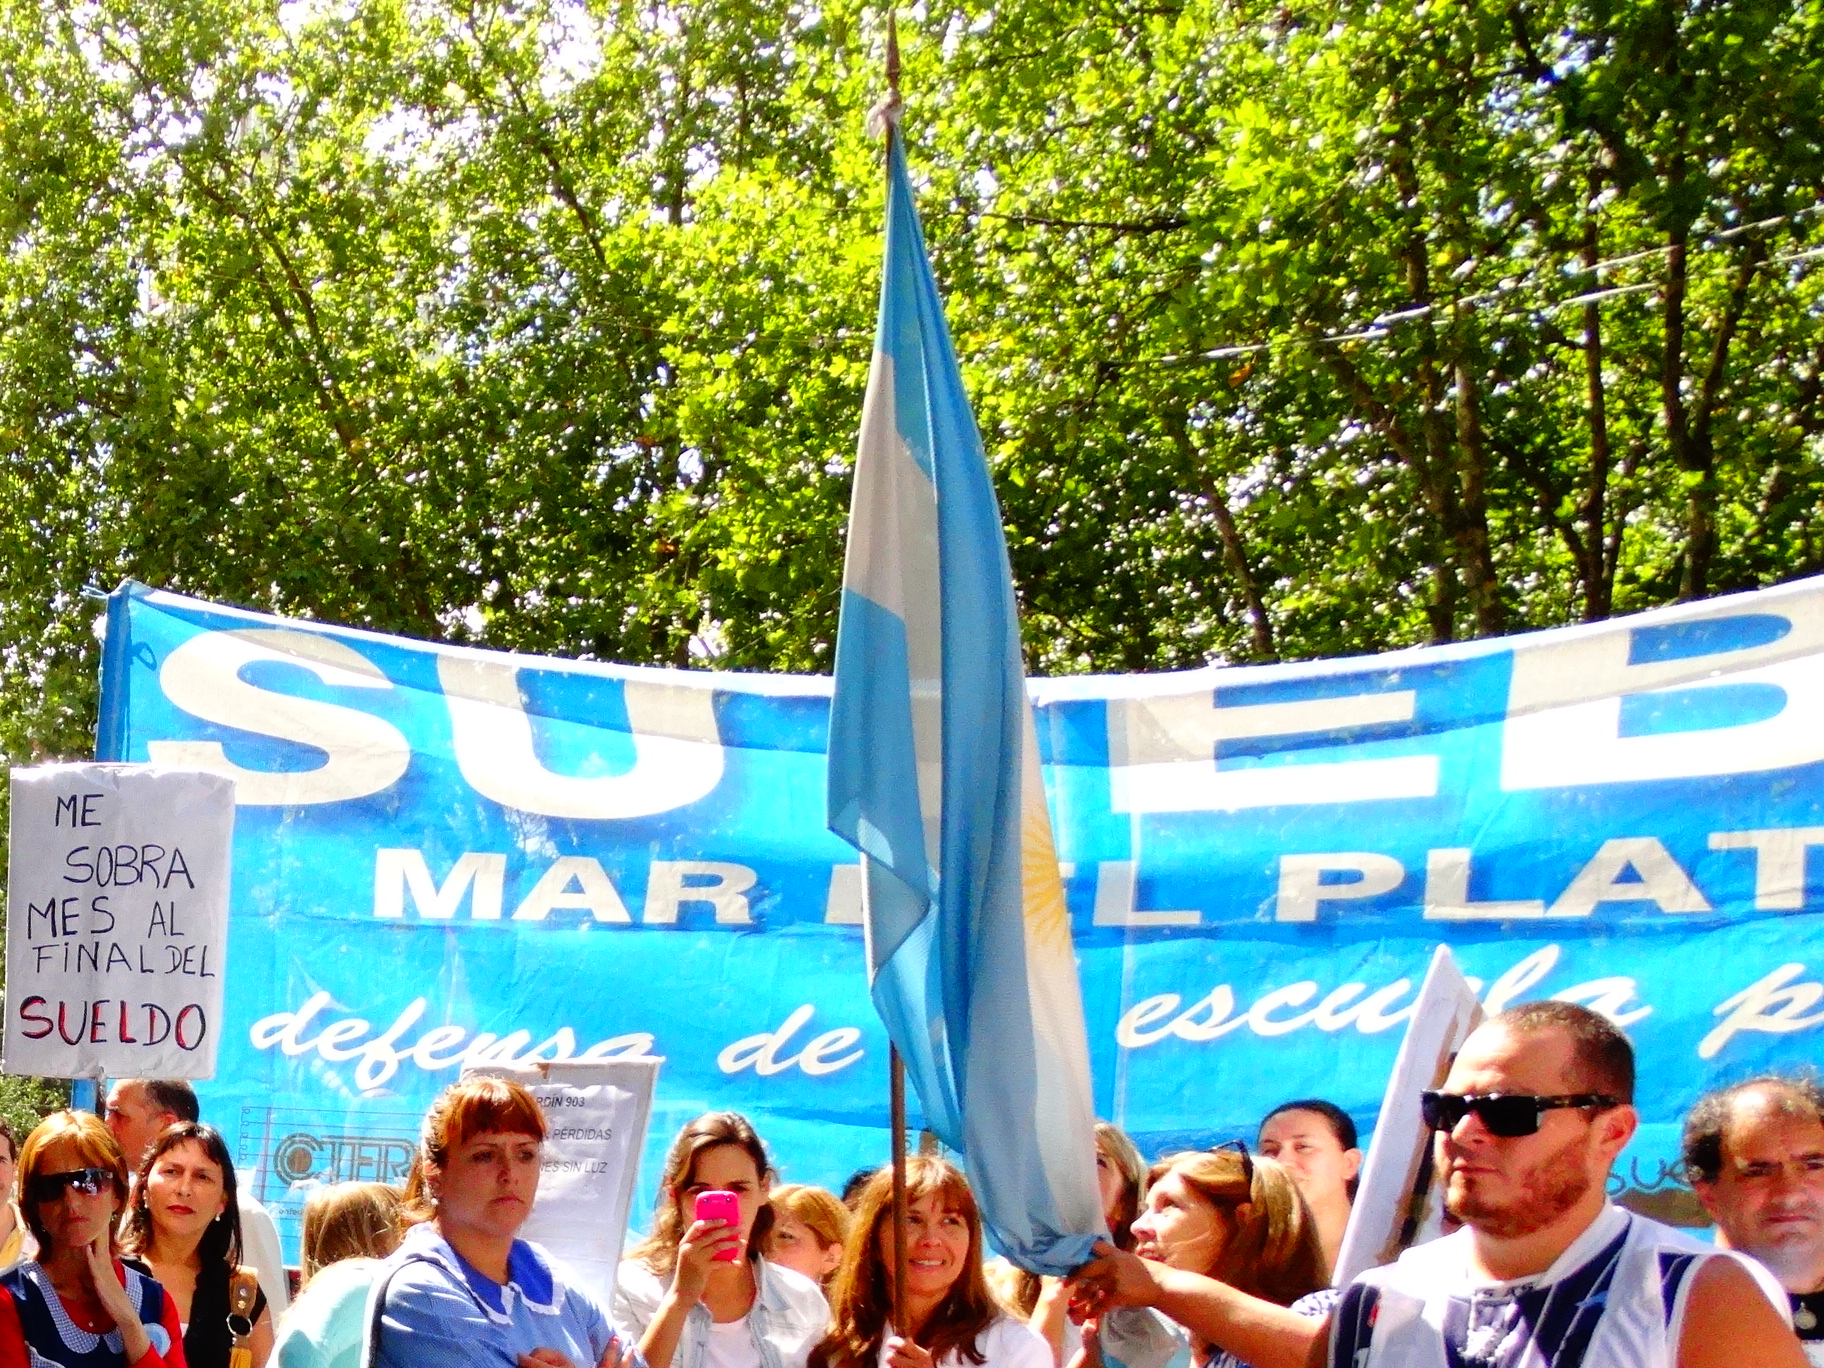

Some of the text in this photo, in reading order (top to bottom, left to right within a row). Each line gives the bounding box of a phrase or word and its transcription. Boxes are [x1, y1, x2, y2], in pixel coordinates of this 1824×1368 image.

[55, 794, 104, 828] ME
[63, 844, 195, 889] SOBRA
[377, 848, 757, 926] MAR
[27, 896, 185, 940] MES AL
[165, 945, 216, 978] DEL
[19, 995, 207, 1051] SUELDO
[249, 991, 865, 1090] defensa de
[565, 1096, 585, 1108] 903
[552, 1126, 613, 1141] PÉRDIDAS
[562, 1161, 582, 1173] SIN
[584, 1161, 608, 1173] LUZ
